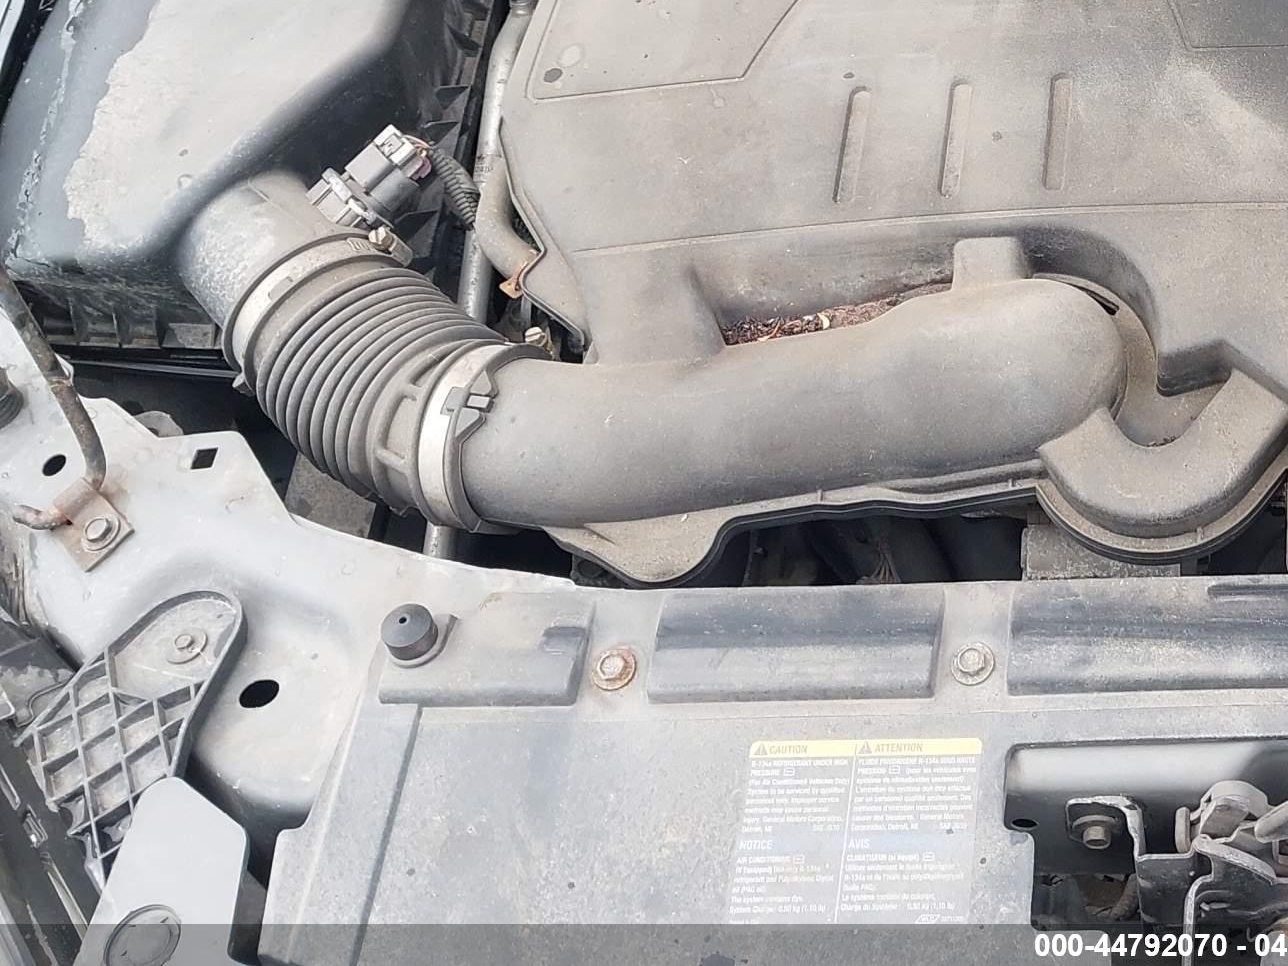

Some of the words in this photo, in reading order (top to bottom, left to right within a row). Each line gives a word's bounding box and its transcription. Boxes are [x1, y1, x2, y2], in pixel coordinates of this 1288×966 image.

[769, 744, 808, 755] CAUTION
[875, 743, 923, 752] ATTENTION
[739, 840, 773, 850] NOTICE
[848, 839, 870, 849] AVIS
